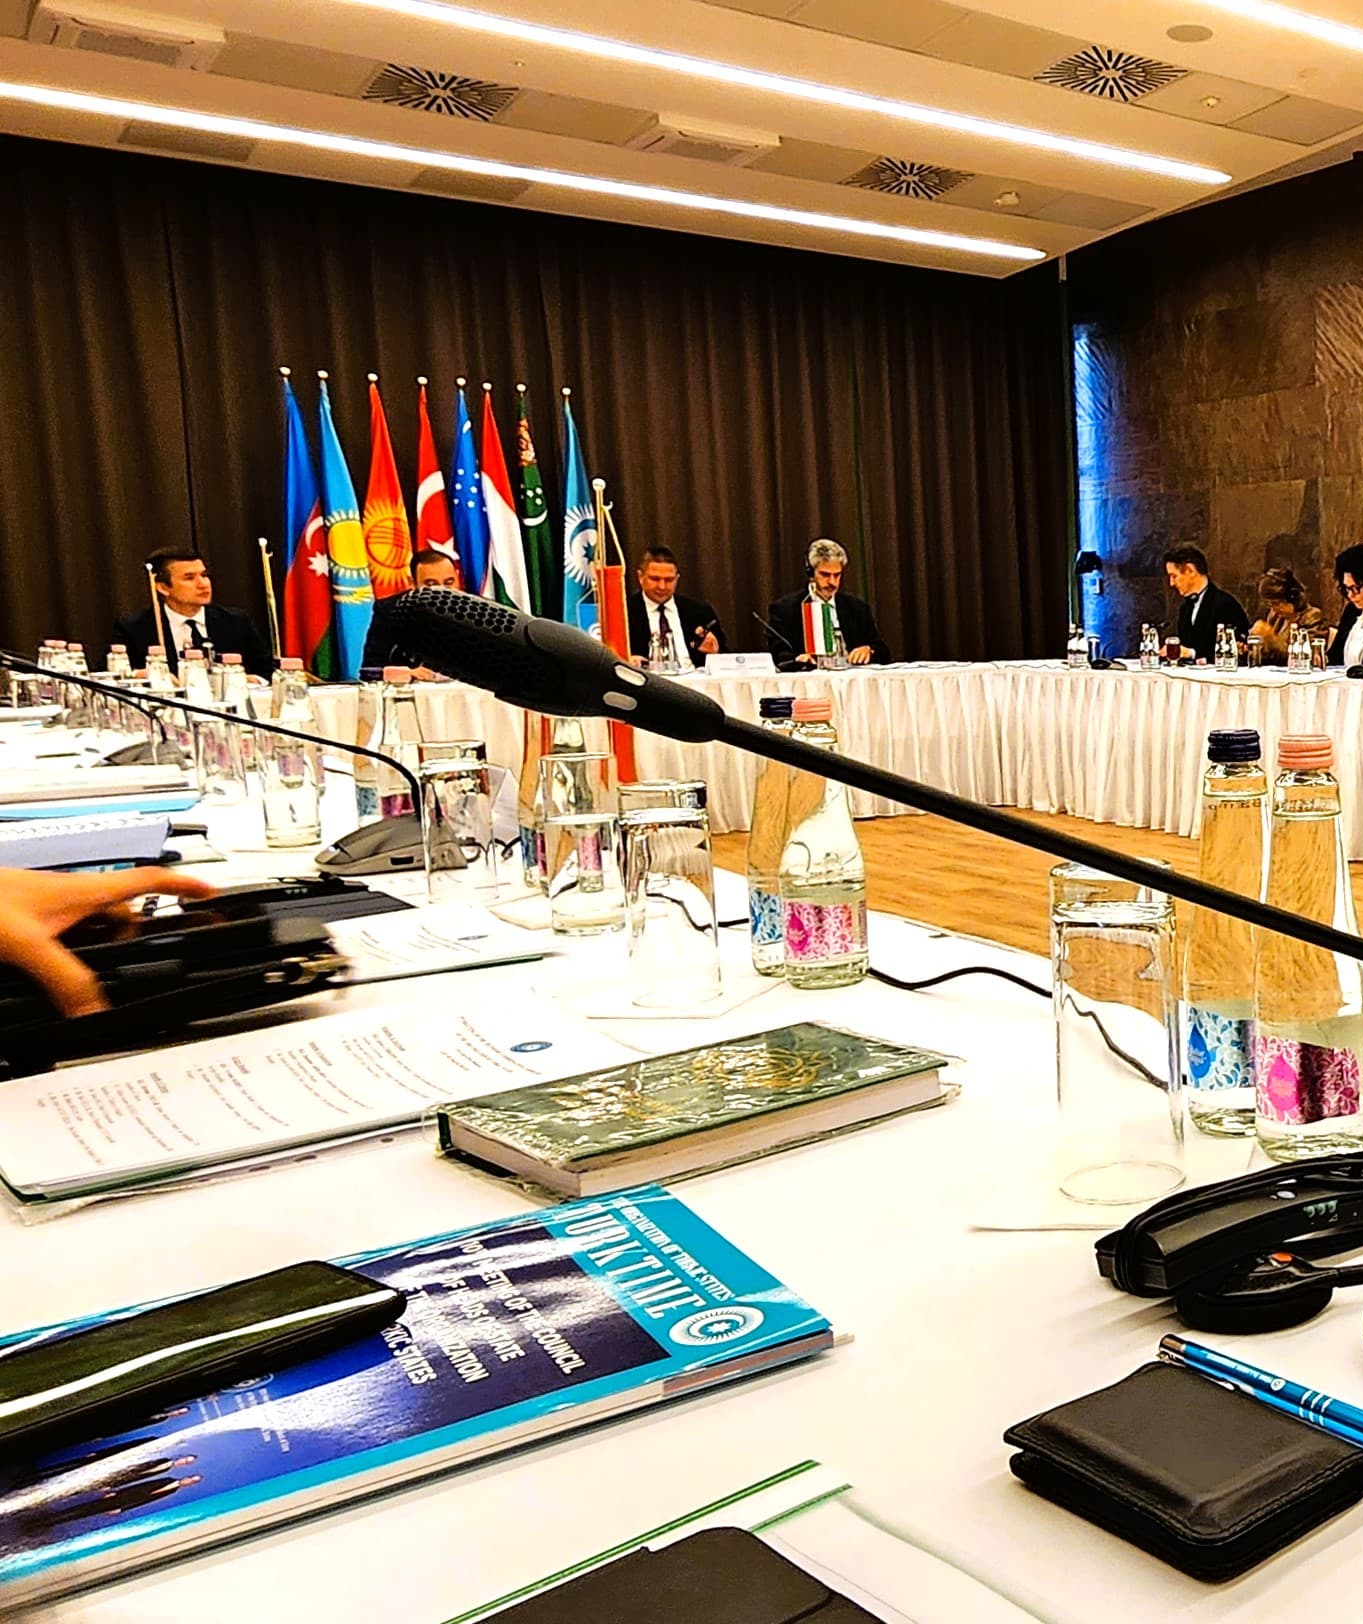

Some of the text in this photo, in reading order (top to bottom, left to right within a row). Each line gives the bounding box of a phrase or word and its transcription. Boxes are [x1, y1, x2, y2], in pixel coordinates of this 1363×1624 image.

[503, 1295, 533, 1313] OF
[517, 1308, 546, 1331] THE
[379, 1324, 438, 1385] RKIC STATES
[483, 1327, 526, 1362] STATE
[531, 1327, 587, 1375] COUNCIL
